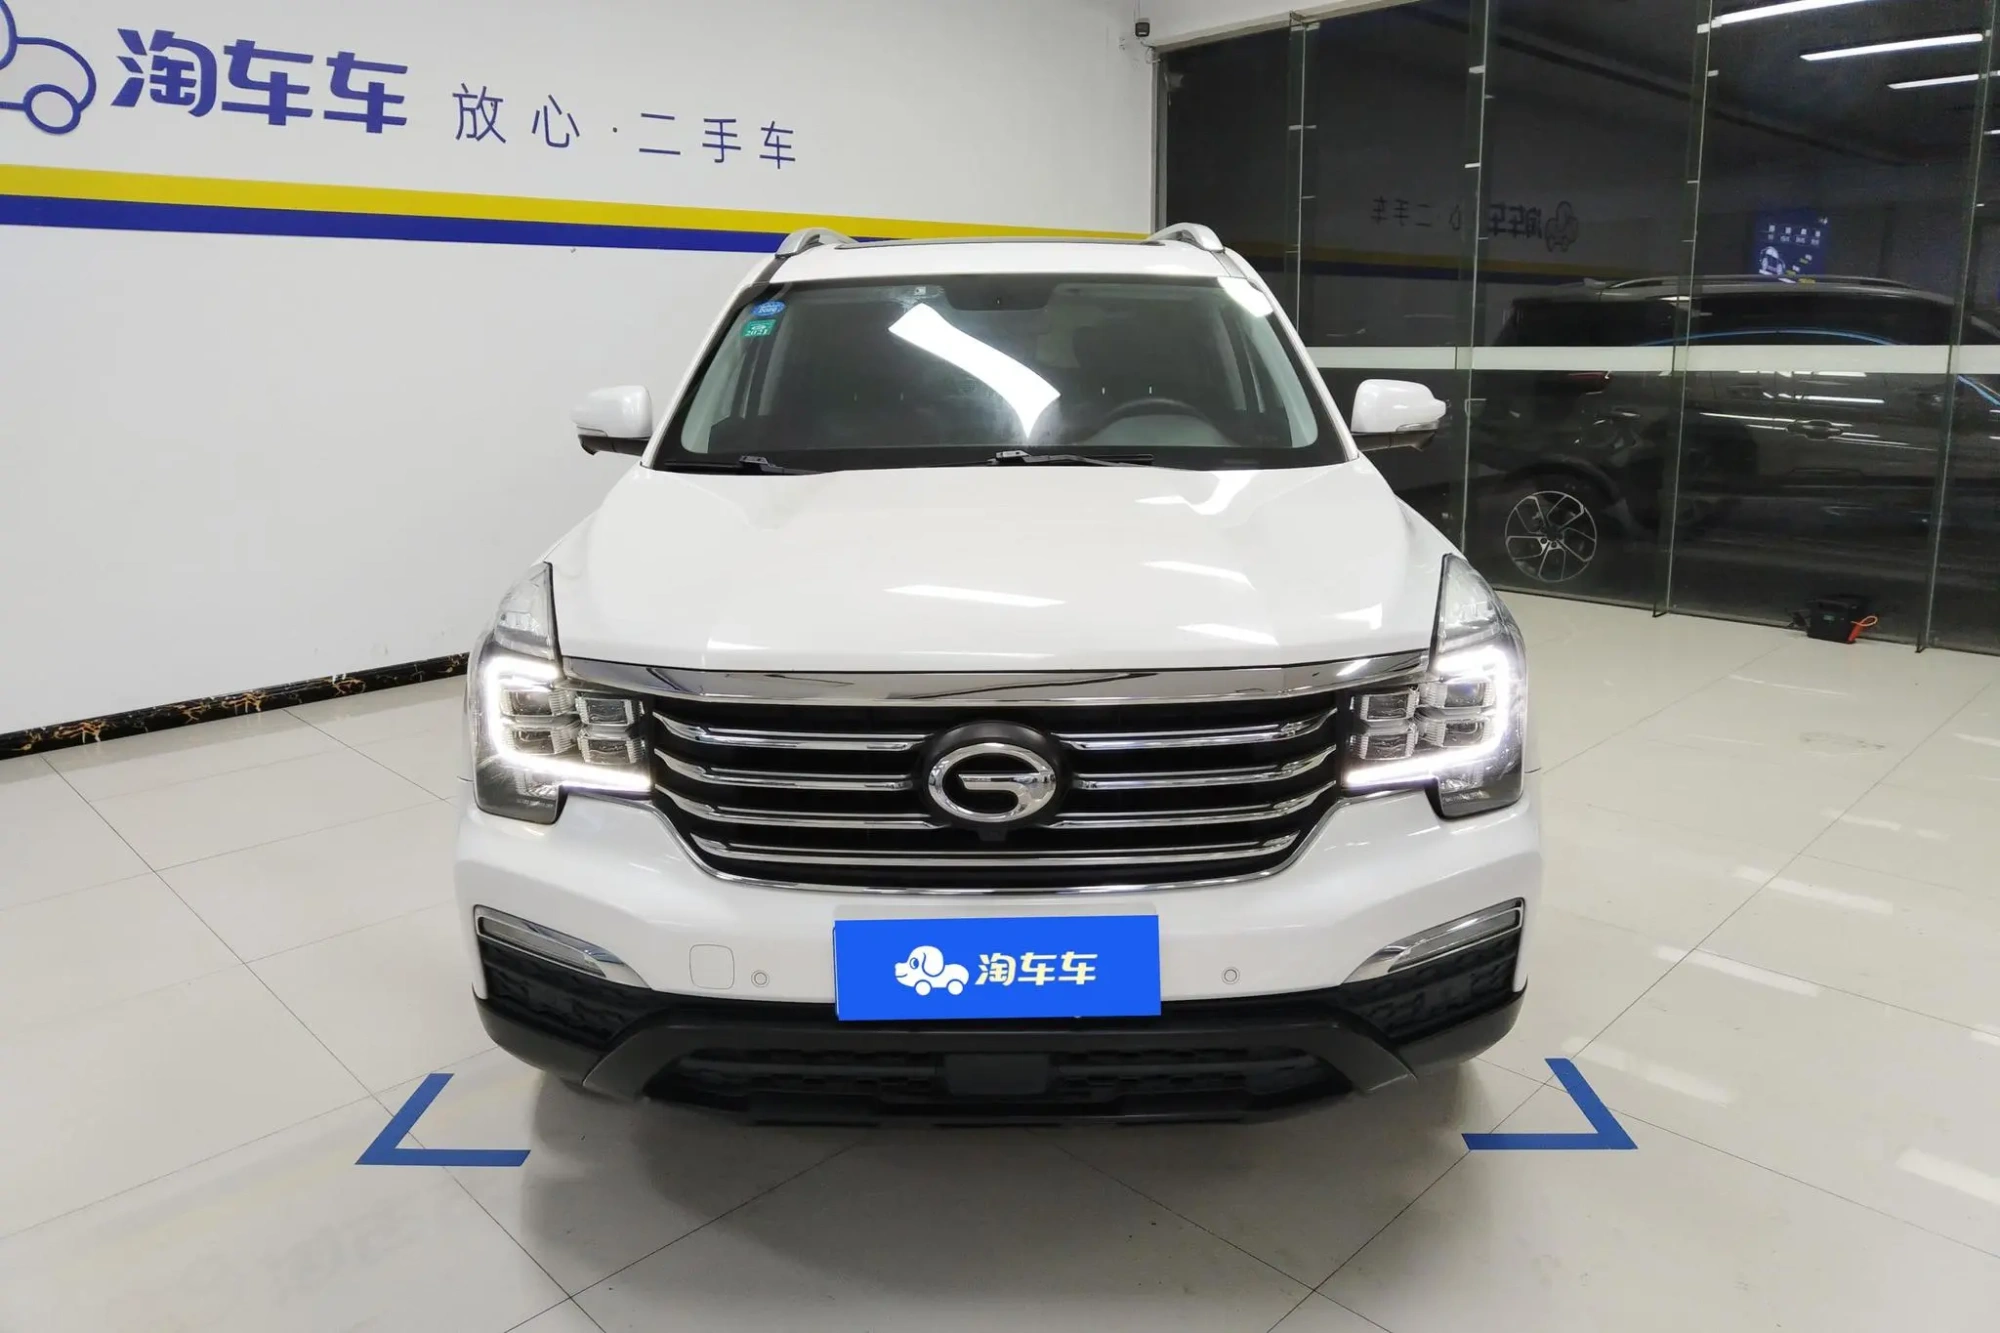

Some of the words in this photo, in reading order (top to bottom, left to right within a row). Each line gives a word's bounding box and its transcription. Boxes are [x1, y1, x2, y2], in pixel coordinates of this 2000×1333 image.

[111, 28, 408, 134] 淘车车
[975, 951, 1098, 986] 淘车车
